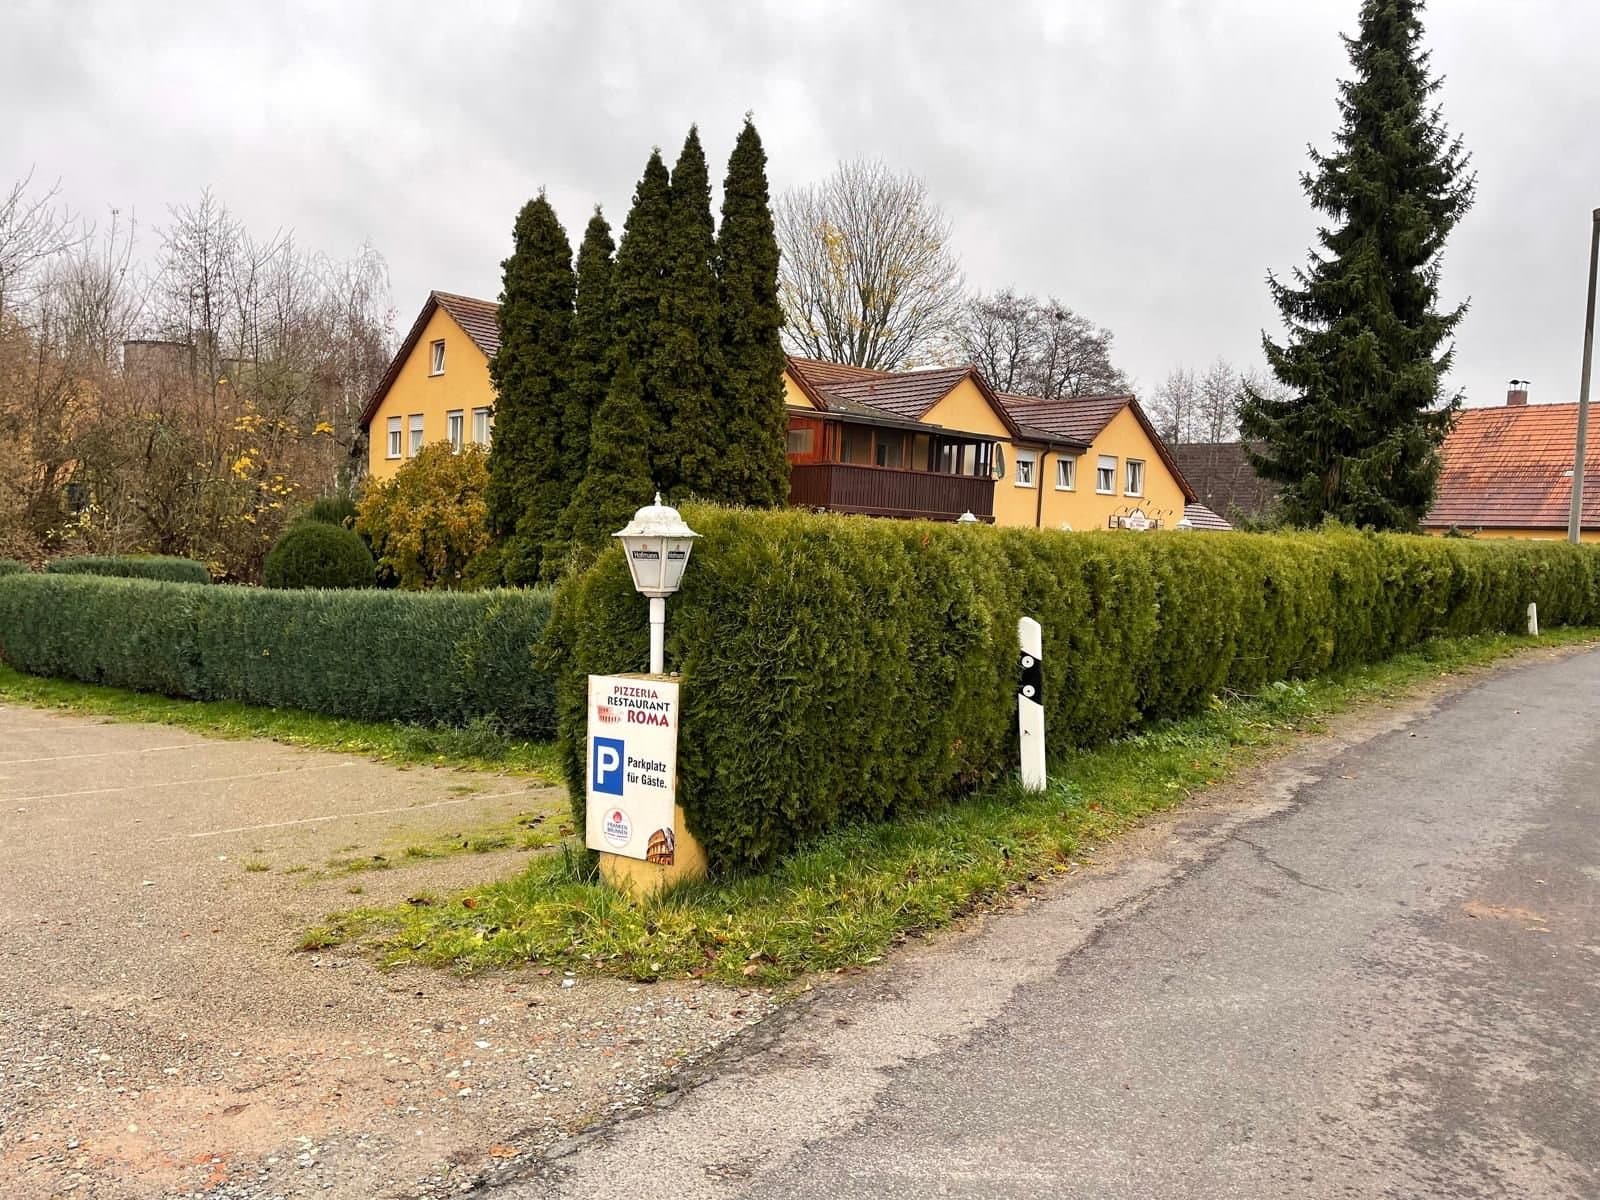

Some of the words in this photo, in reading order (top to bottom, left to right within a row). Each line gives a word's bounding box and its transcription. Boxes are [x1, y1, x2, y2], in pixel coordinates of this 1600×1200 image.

[614, 686, 658, 699] PIZZERIA
[608, 696, 670, 712] RESTAURANT
[627, 710, 669, 727] ROMA
[597, 745, 620, 784] P
[627, 756, 666, 773] Parkplatz
[627, 772, 639, 784] für
[641, 774, 667, 788] Gäste.
